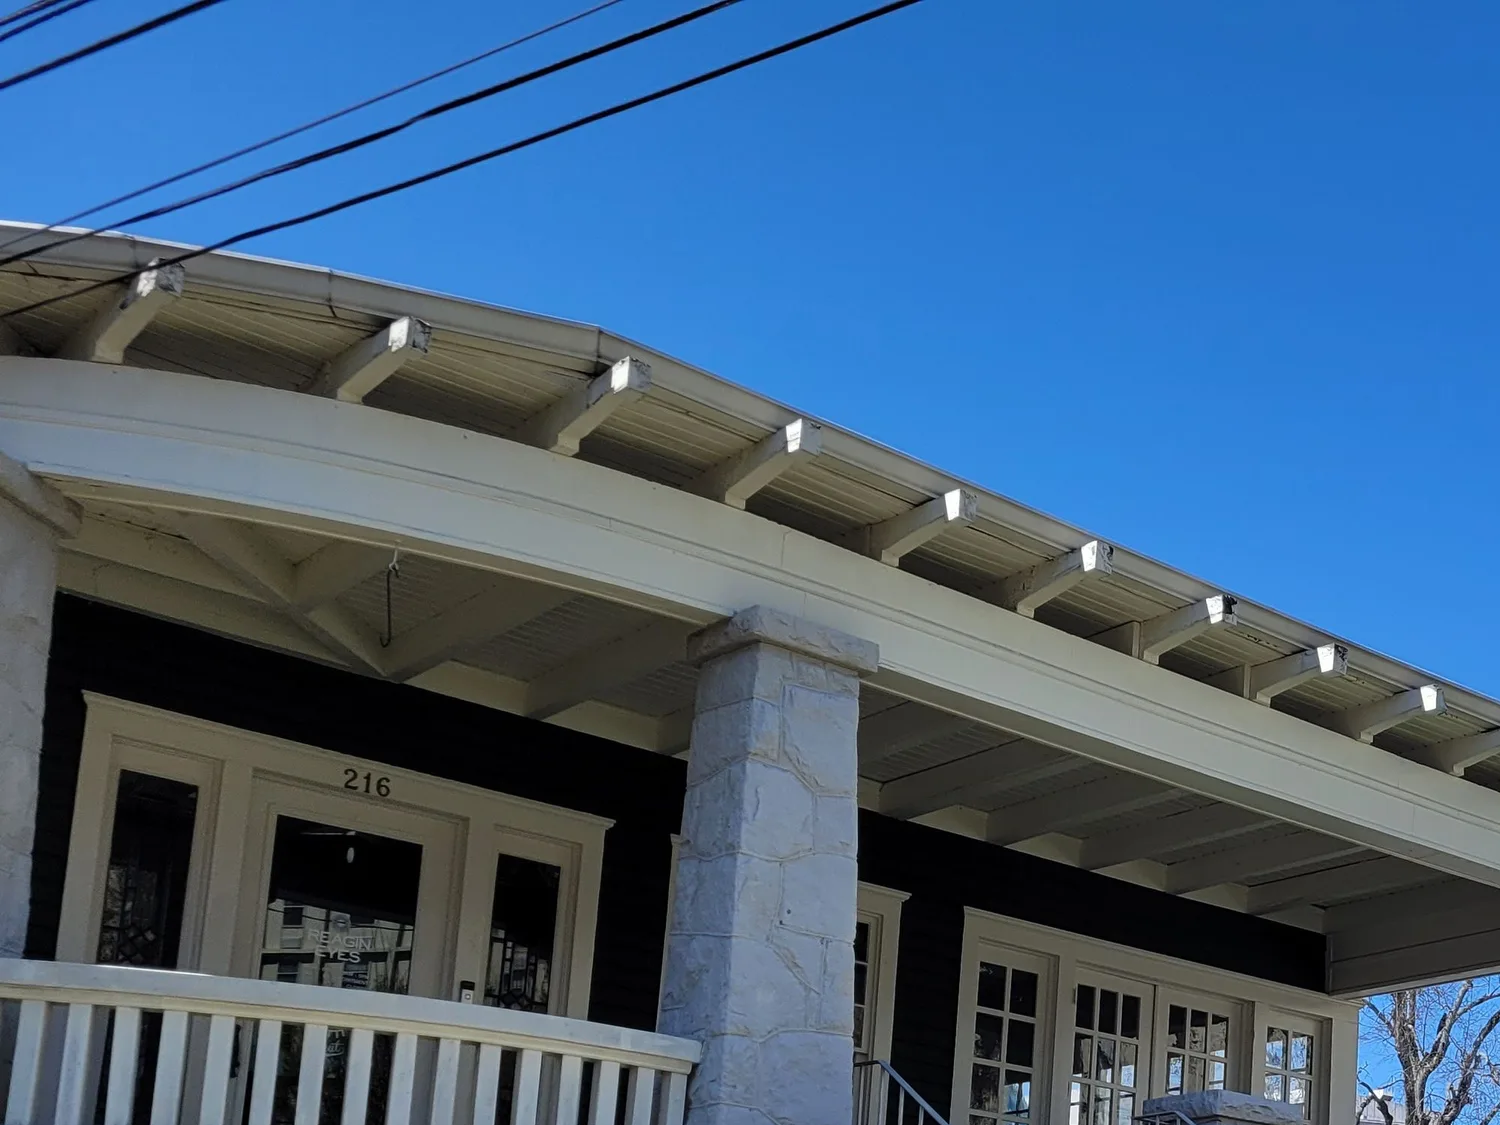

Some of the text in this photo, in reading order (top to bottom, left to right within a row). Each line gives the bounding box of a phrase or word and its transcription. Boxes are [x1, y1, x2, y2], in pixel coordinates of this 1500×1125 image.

[344, 768, 391, 797] 216
[307, 928, 372, 951] REAGIN
[315, 944, 361, 964] EYES
